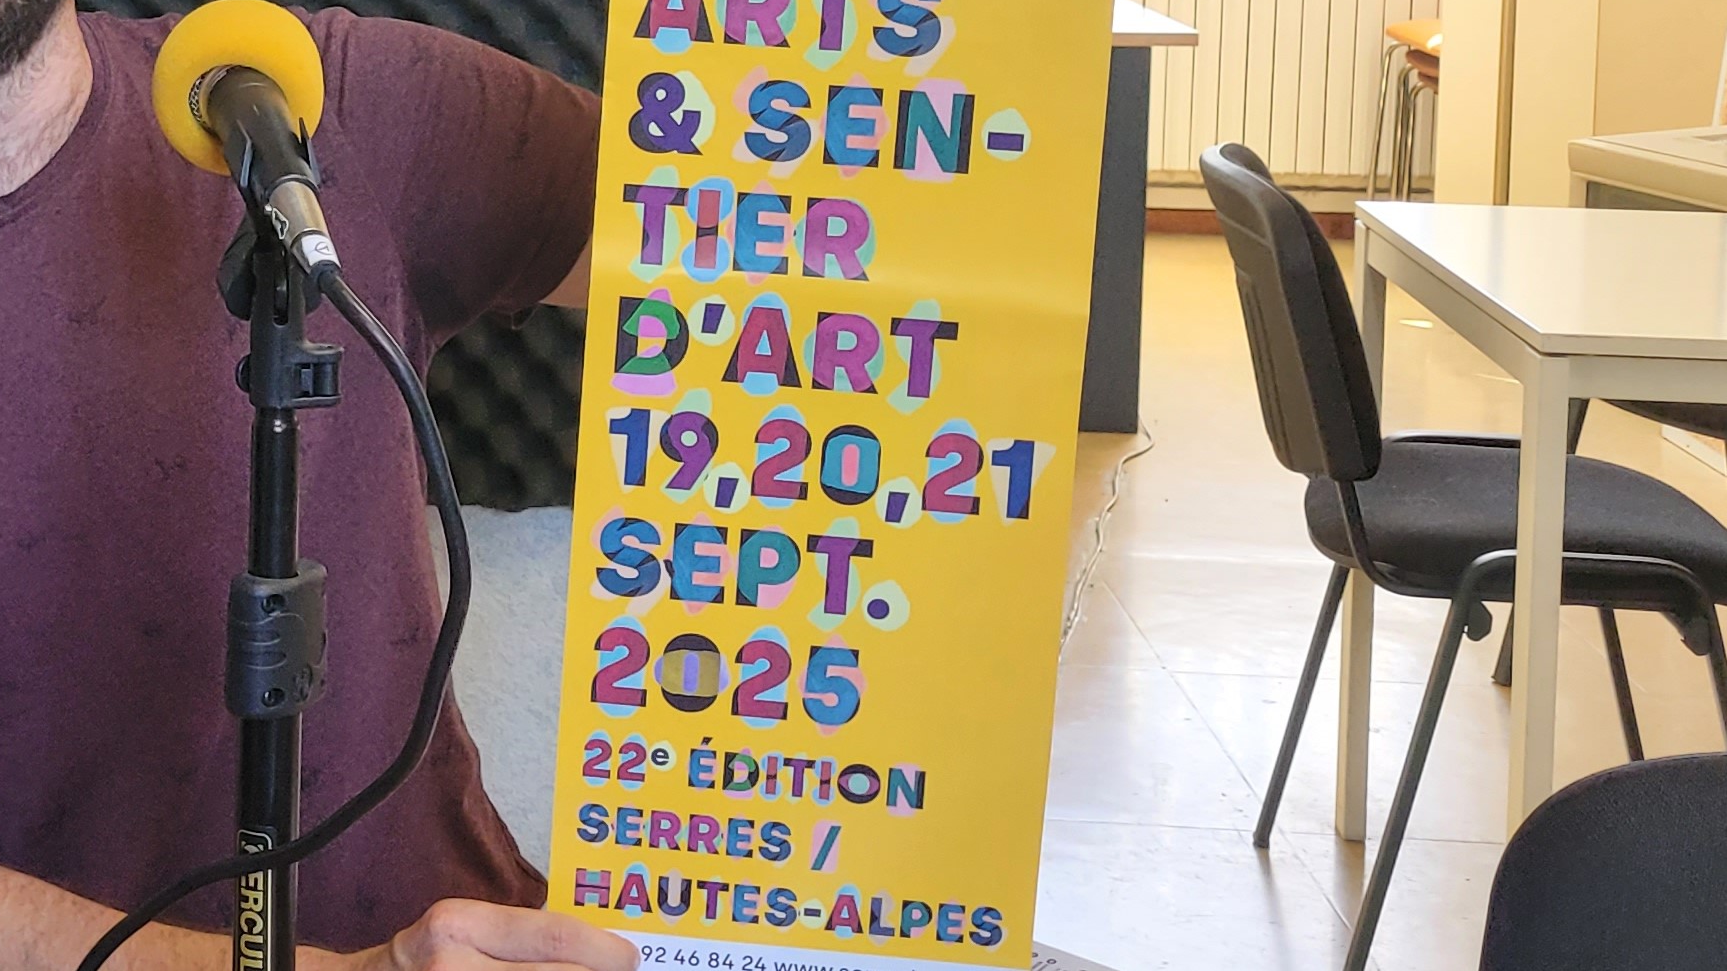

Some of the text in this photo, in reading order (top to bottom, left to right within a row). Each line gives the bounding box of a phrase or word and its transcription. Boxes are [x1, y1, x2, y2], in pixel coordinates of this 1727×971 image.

[628, 72, 1025, 175] & SEN-
[623, 184, 872, 281] TIER
[613, 295, 959, 398] D'ART
[608, 408, 1035, 524] 19,20,21
[596, 517, 890, 620] SEPT.
[591, 626, 862, 727] 2025
[688, 737, 926, 809] ÉDITION
[576, 804, 841, 870] SERRES /
[574, 868, 1003, 946] HAUTES-ALPES
[641, 945, 667, 963] 92
[673, 949, 700, 966] 46
[707, 952, 734, 970] 84
[742, 955, 767, 971] 24
